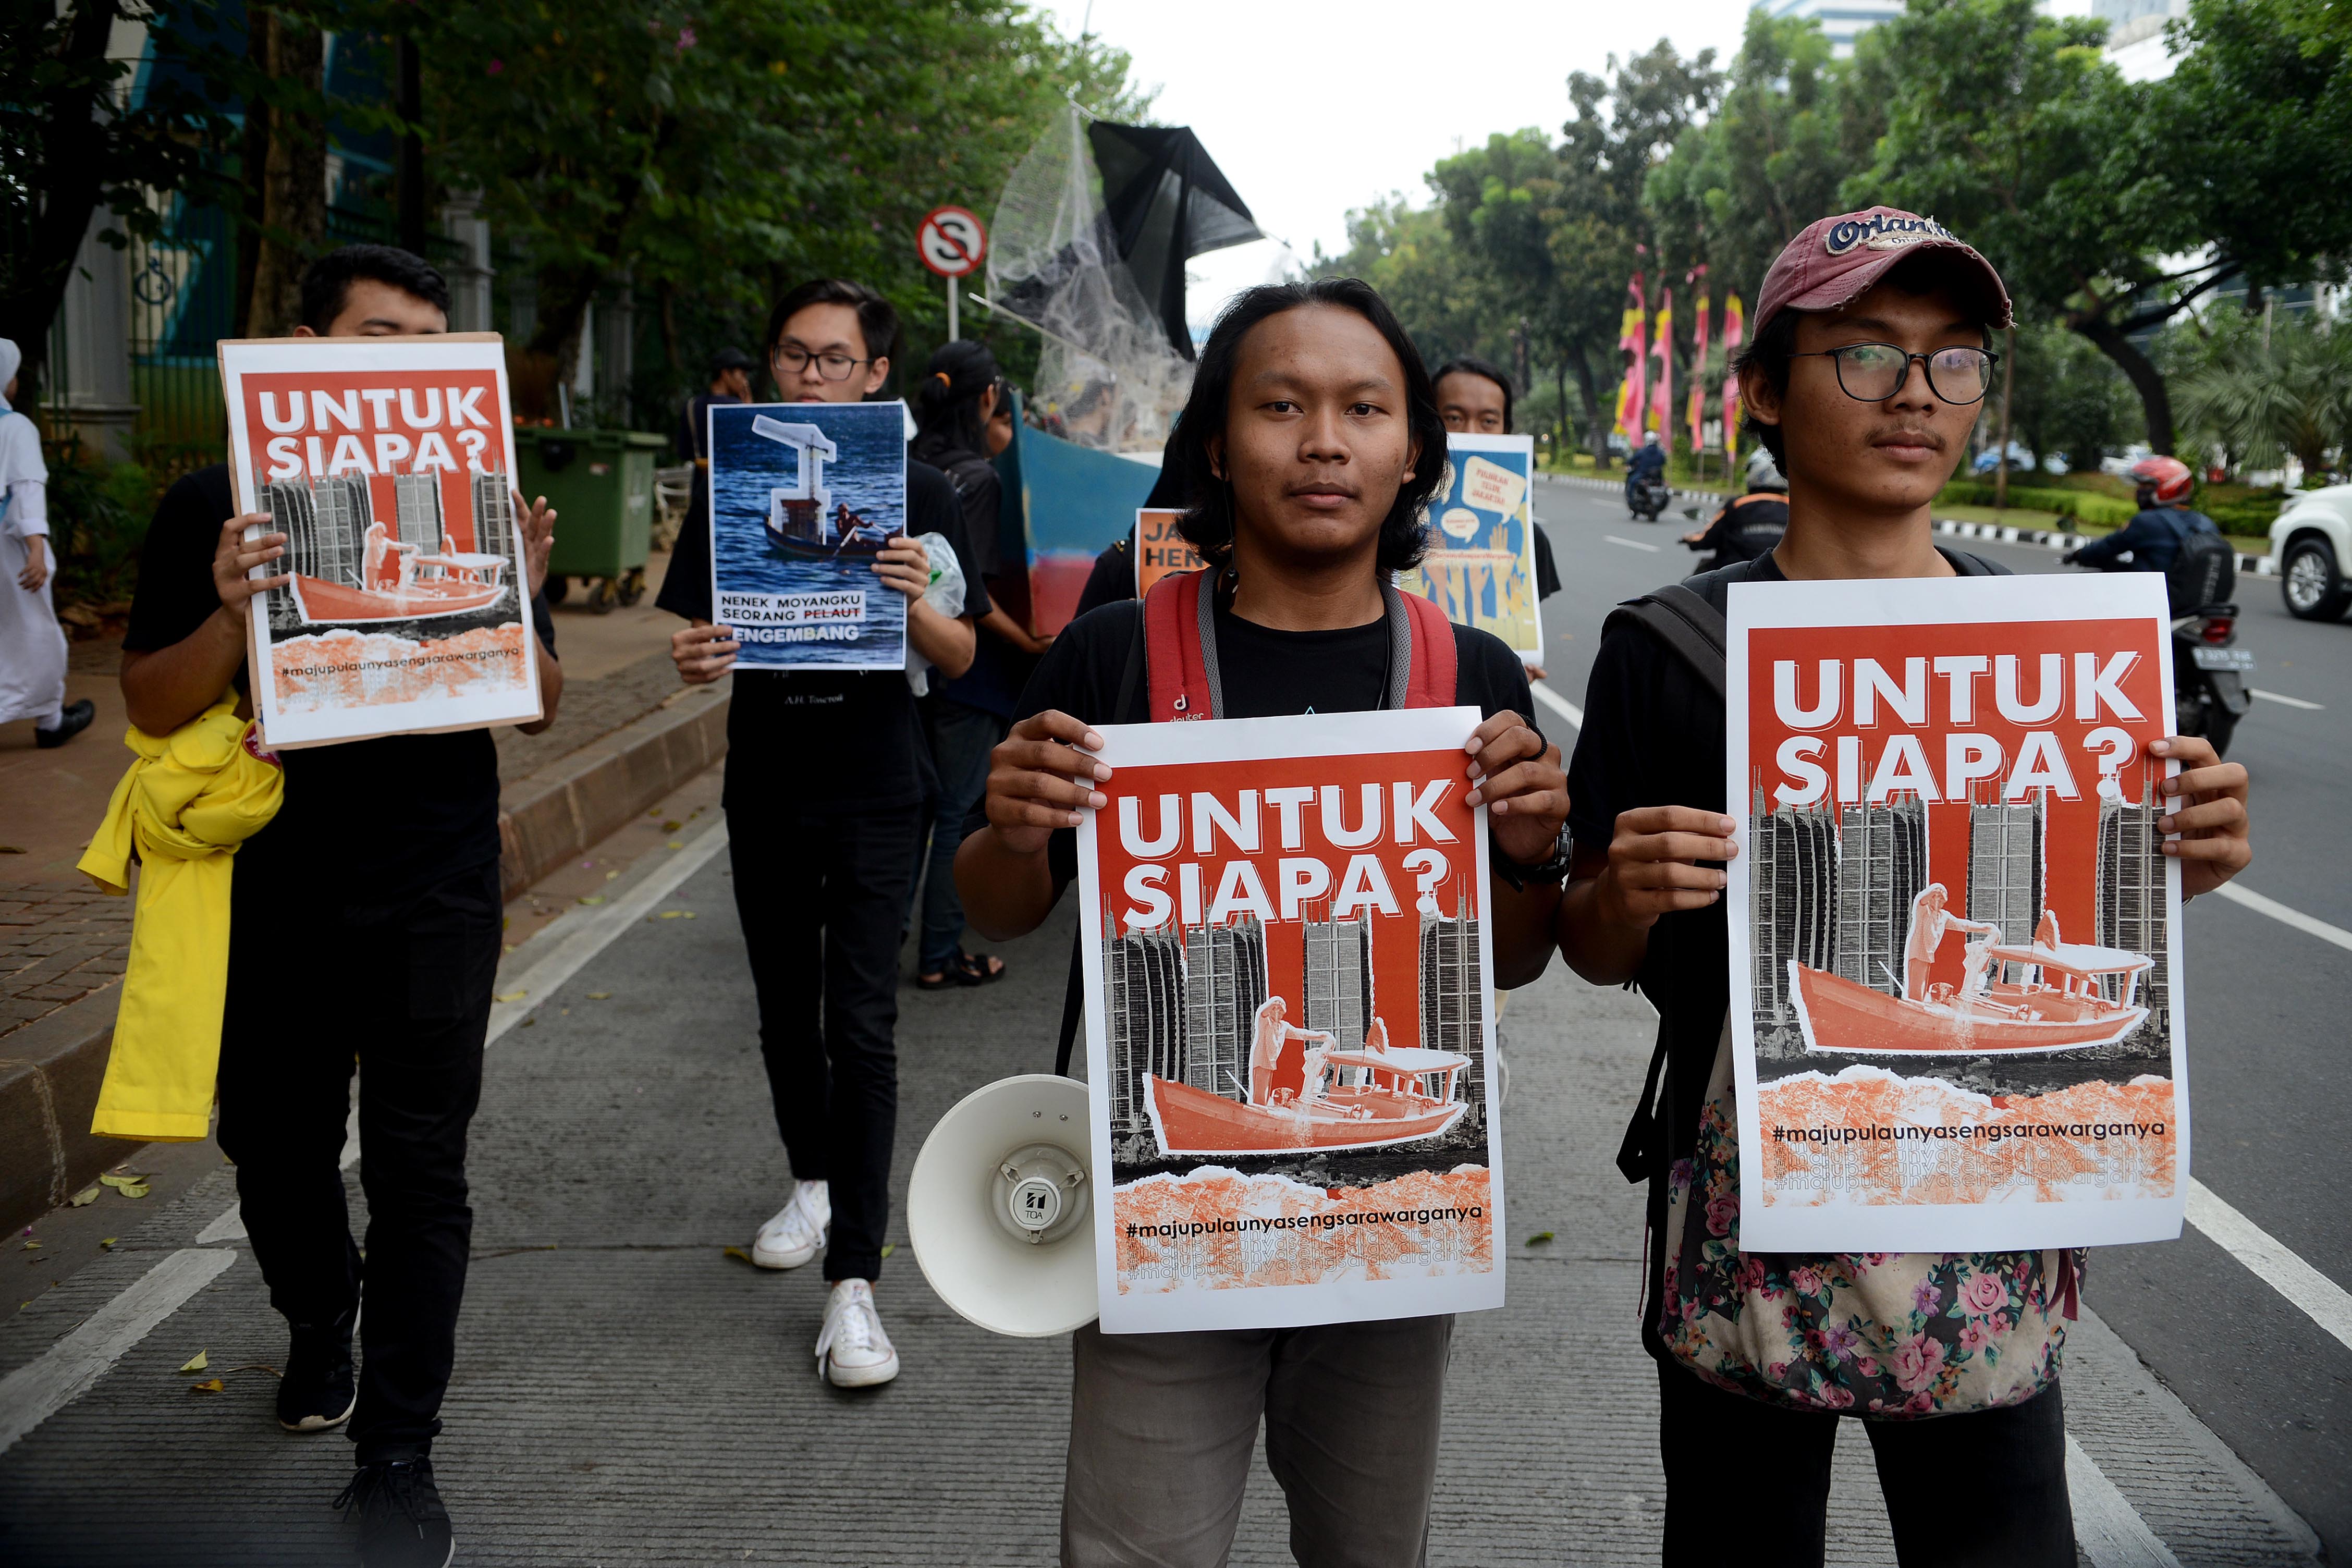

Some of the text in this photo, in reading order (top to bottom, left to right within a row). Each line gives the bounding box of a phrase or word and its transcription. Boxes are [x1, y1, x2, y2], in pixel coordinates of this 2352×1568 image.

[937, 222, 967, 260] S
[259, 387, 493, 435] UNTUK
[266, 429, 487, 479] SIAPA?
[1145, 523, 1182, 542] JA
[1145, 548, 1203, 567] HEN
[722, 595, 860, 608] NENEK MOYANGKU
[722, 608, 860, 621] SEORANG PELAUT
[725, 625, 859, 643] ENGEMBANG
[282, 647, 519, 677] #majupulaunyasengsarawarganya
[1773, 651, 2147, 732] UNTUK
[1773, 726, 2137, 809] SIAPA?
[1118, 778, 1460, 861] UNTUK
[1122, 847, 1452, 931] SIAPA?
[1773, 1123, 2165, 1145] #majupulaunyasengsarawarganya
[1025, 1210, 1043, 1219] TOA
[1126, 1206, 1481, 1239] #majupulaunyasengsarawarganya
